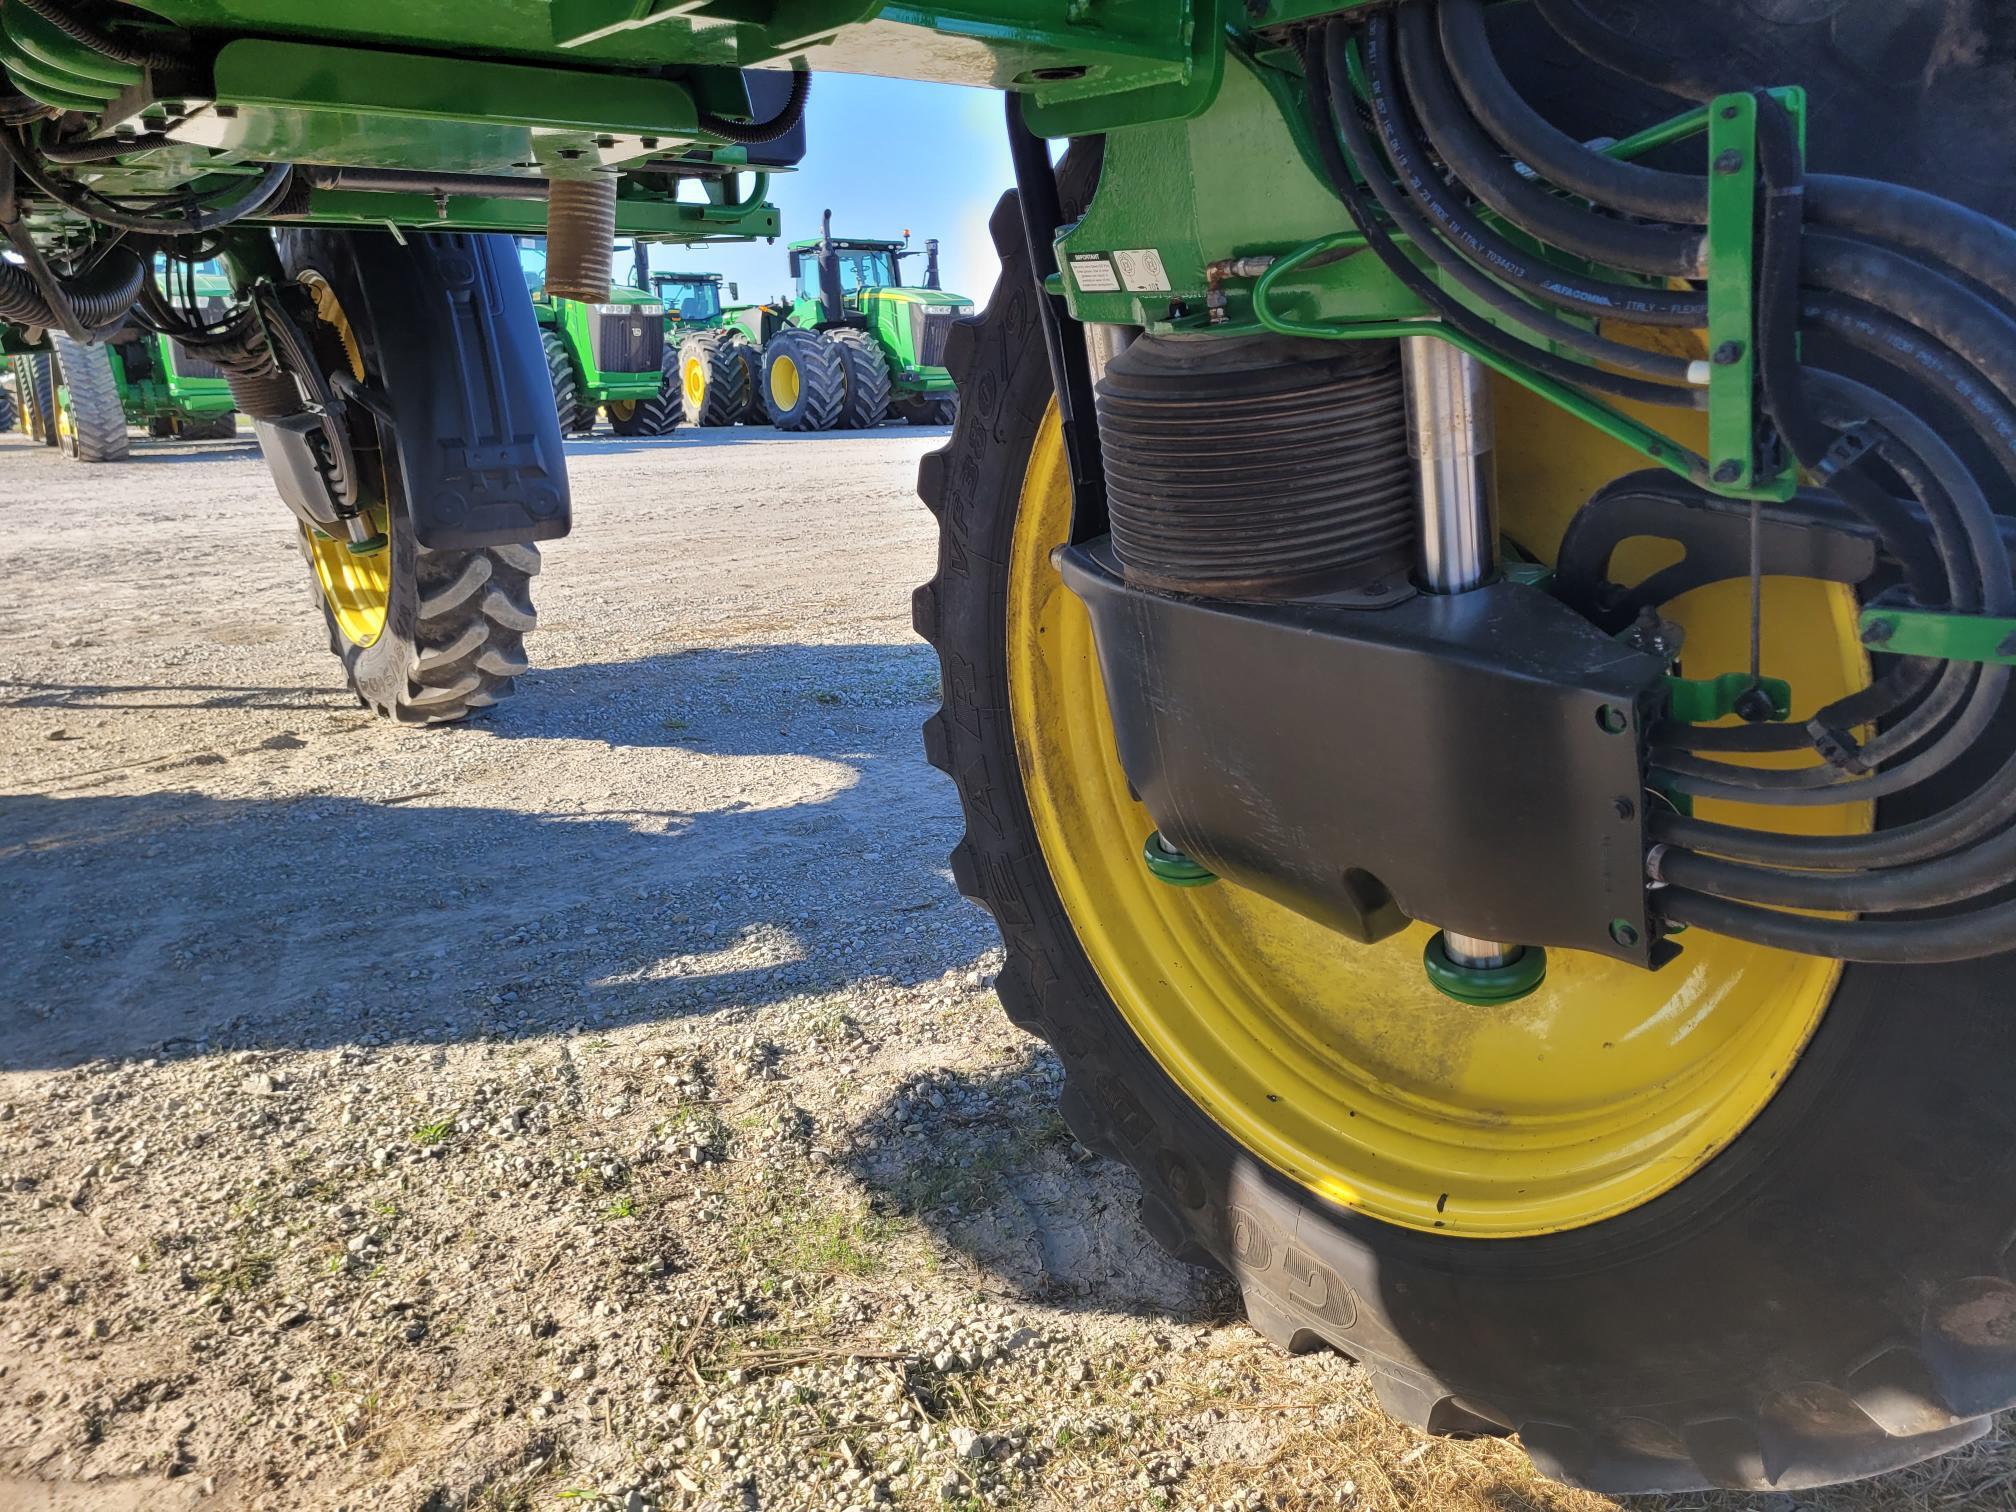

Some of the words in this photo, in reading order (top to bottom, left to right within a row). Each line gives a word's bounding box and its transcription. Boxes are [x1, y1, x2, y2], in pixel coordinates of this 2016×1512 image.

[1429, 201, 1450, 223] MADE
[1448, 220, 1462, 235] IN
[1459, 231, 1485, 255] ITALY
[1625, 300, 1656, 313] ITALY
